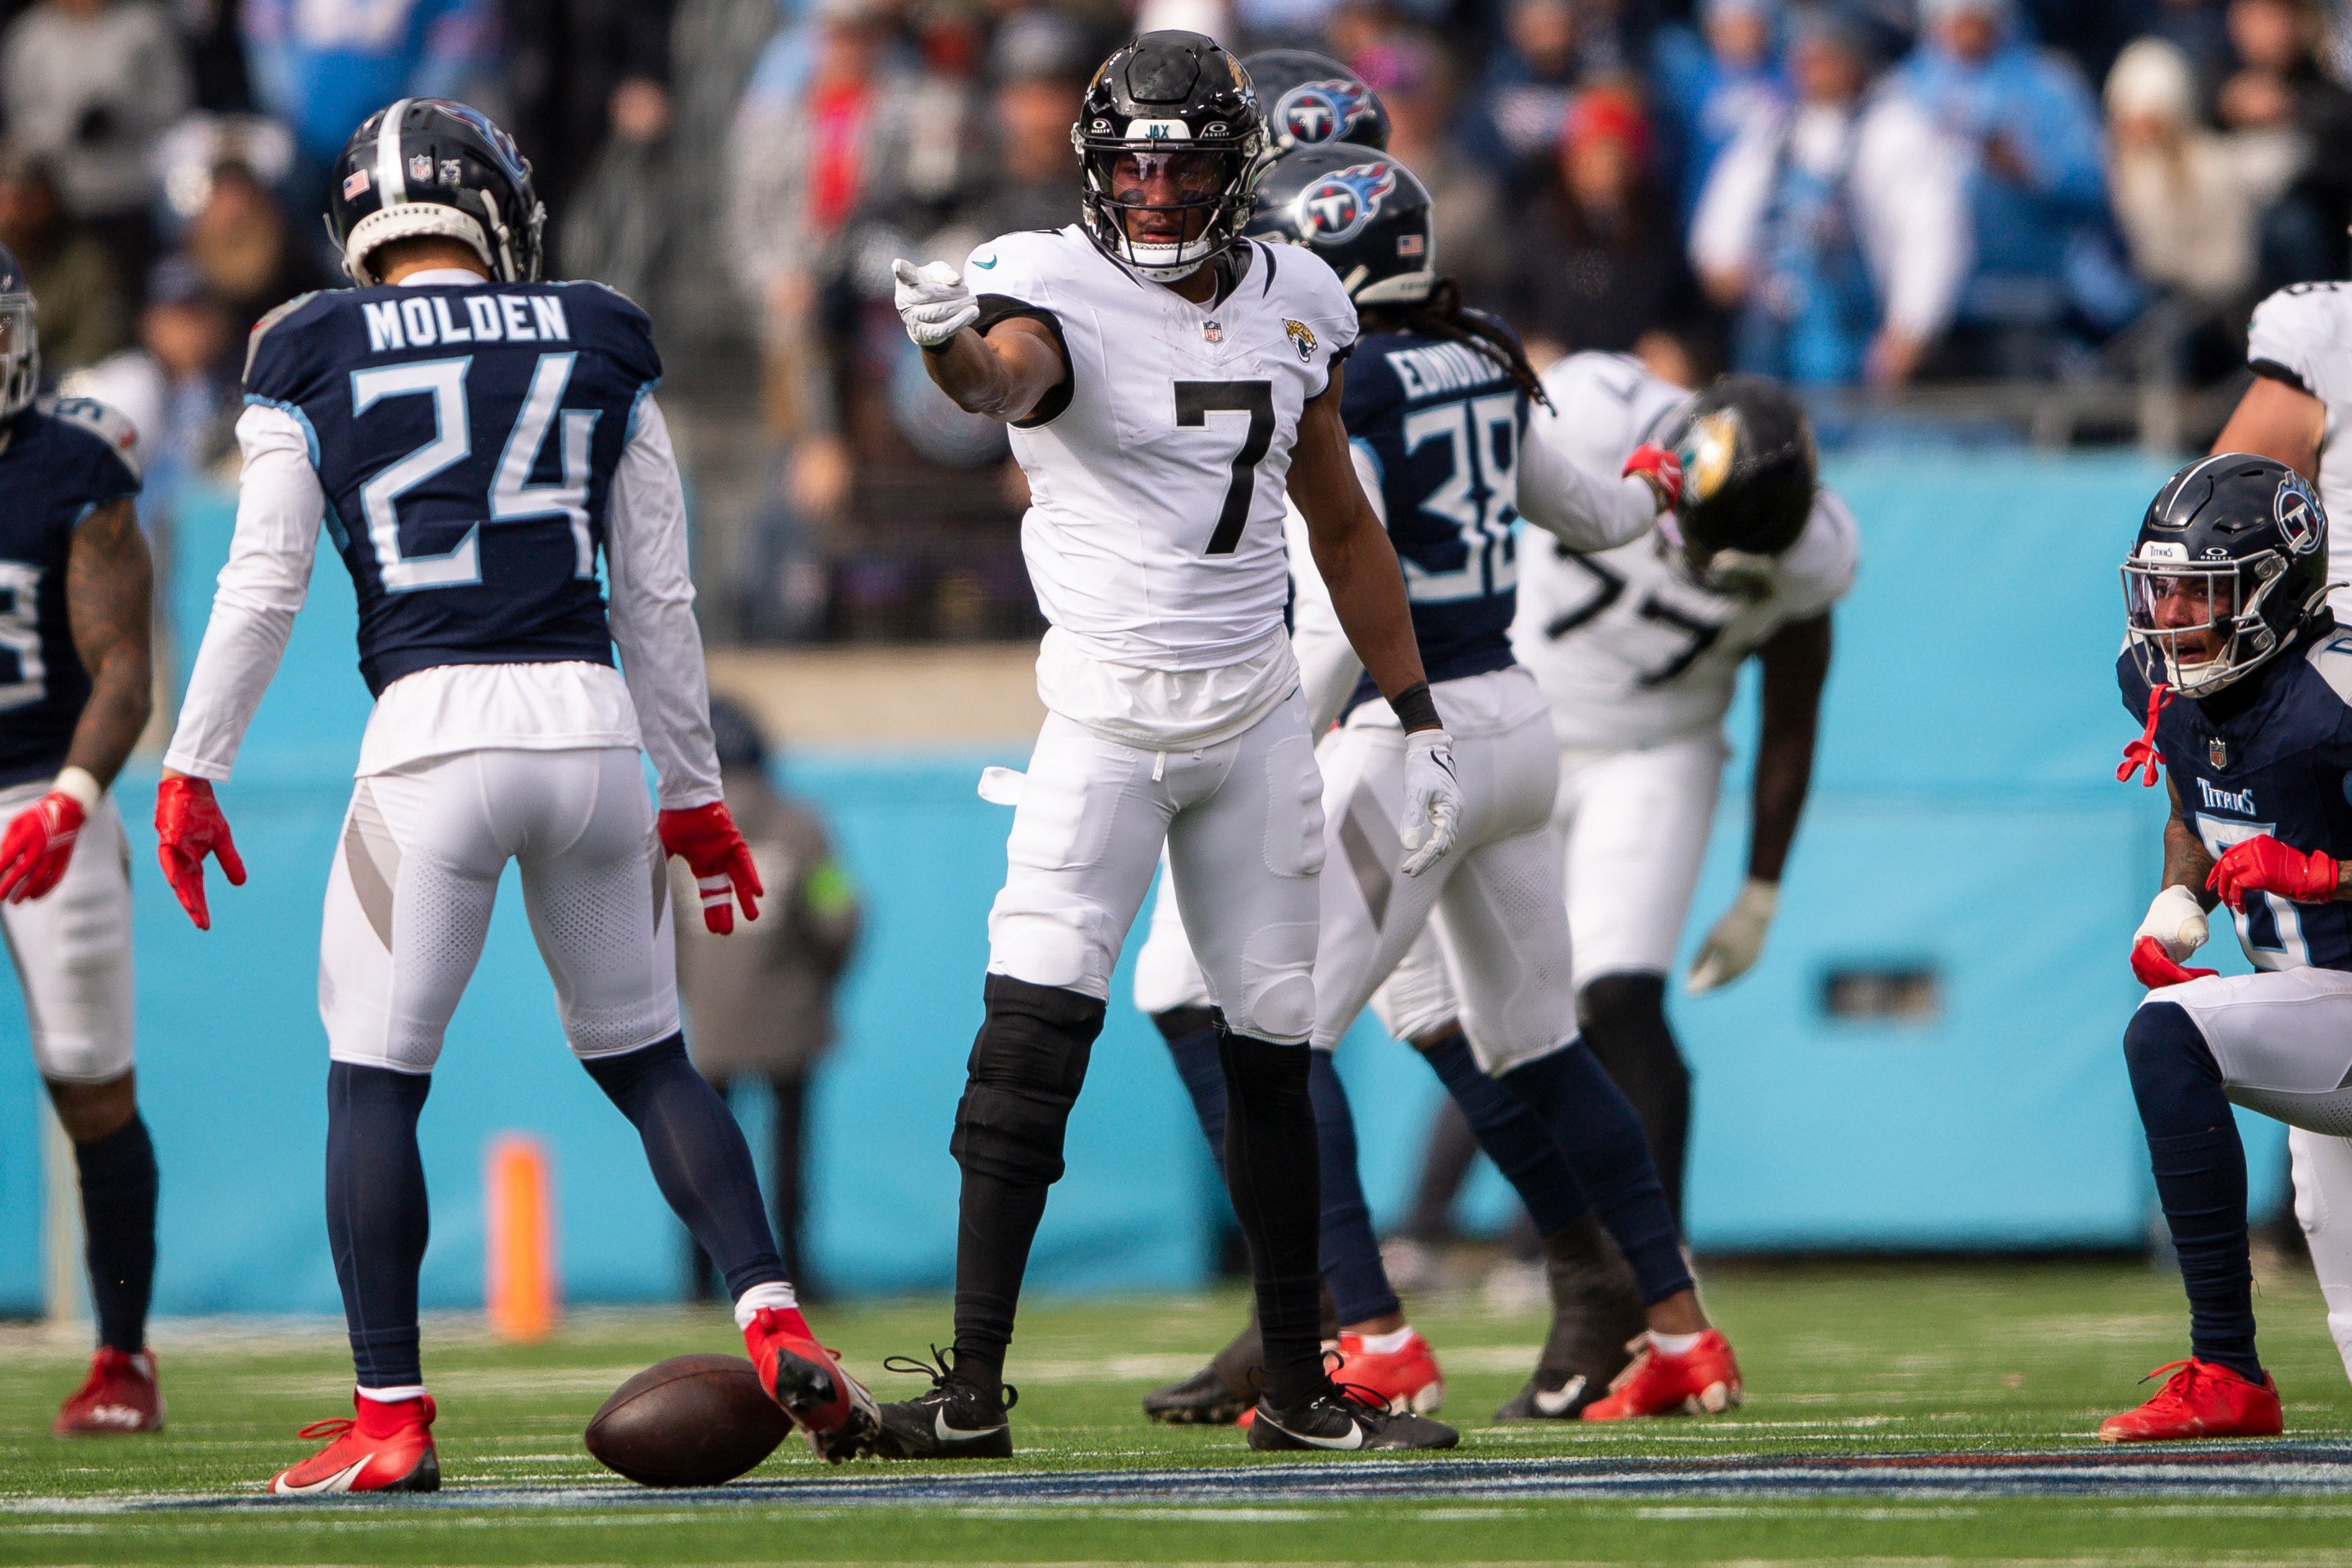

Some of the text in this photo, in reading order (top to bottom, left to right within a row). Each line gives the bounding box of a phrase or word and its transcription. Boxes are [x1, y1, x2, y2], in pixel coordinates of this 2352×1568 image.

[1145, 124, 1169, 139] JAX
[362, 294, 571, 353] MOLDEN
[1206, 329, 1222, 341] NFL
[349, 350, 604, 595] 24
[1170, 377, 1277, 559] 7
[1401, 389, 1519, 604] 38
